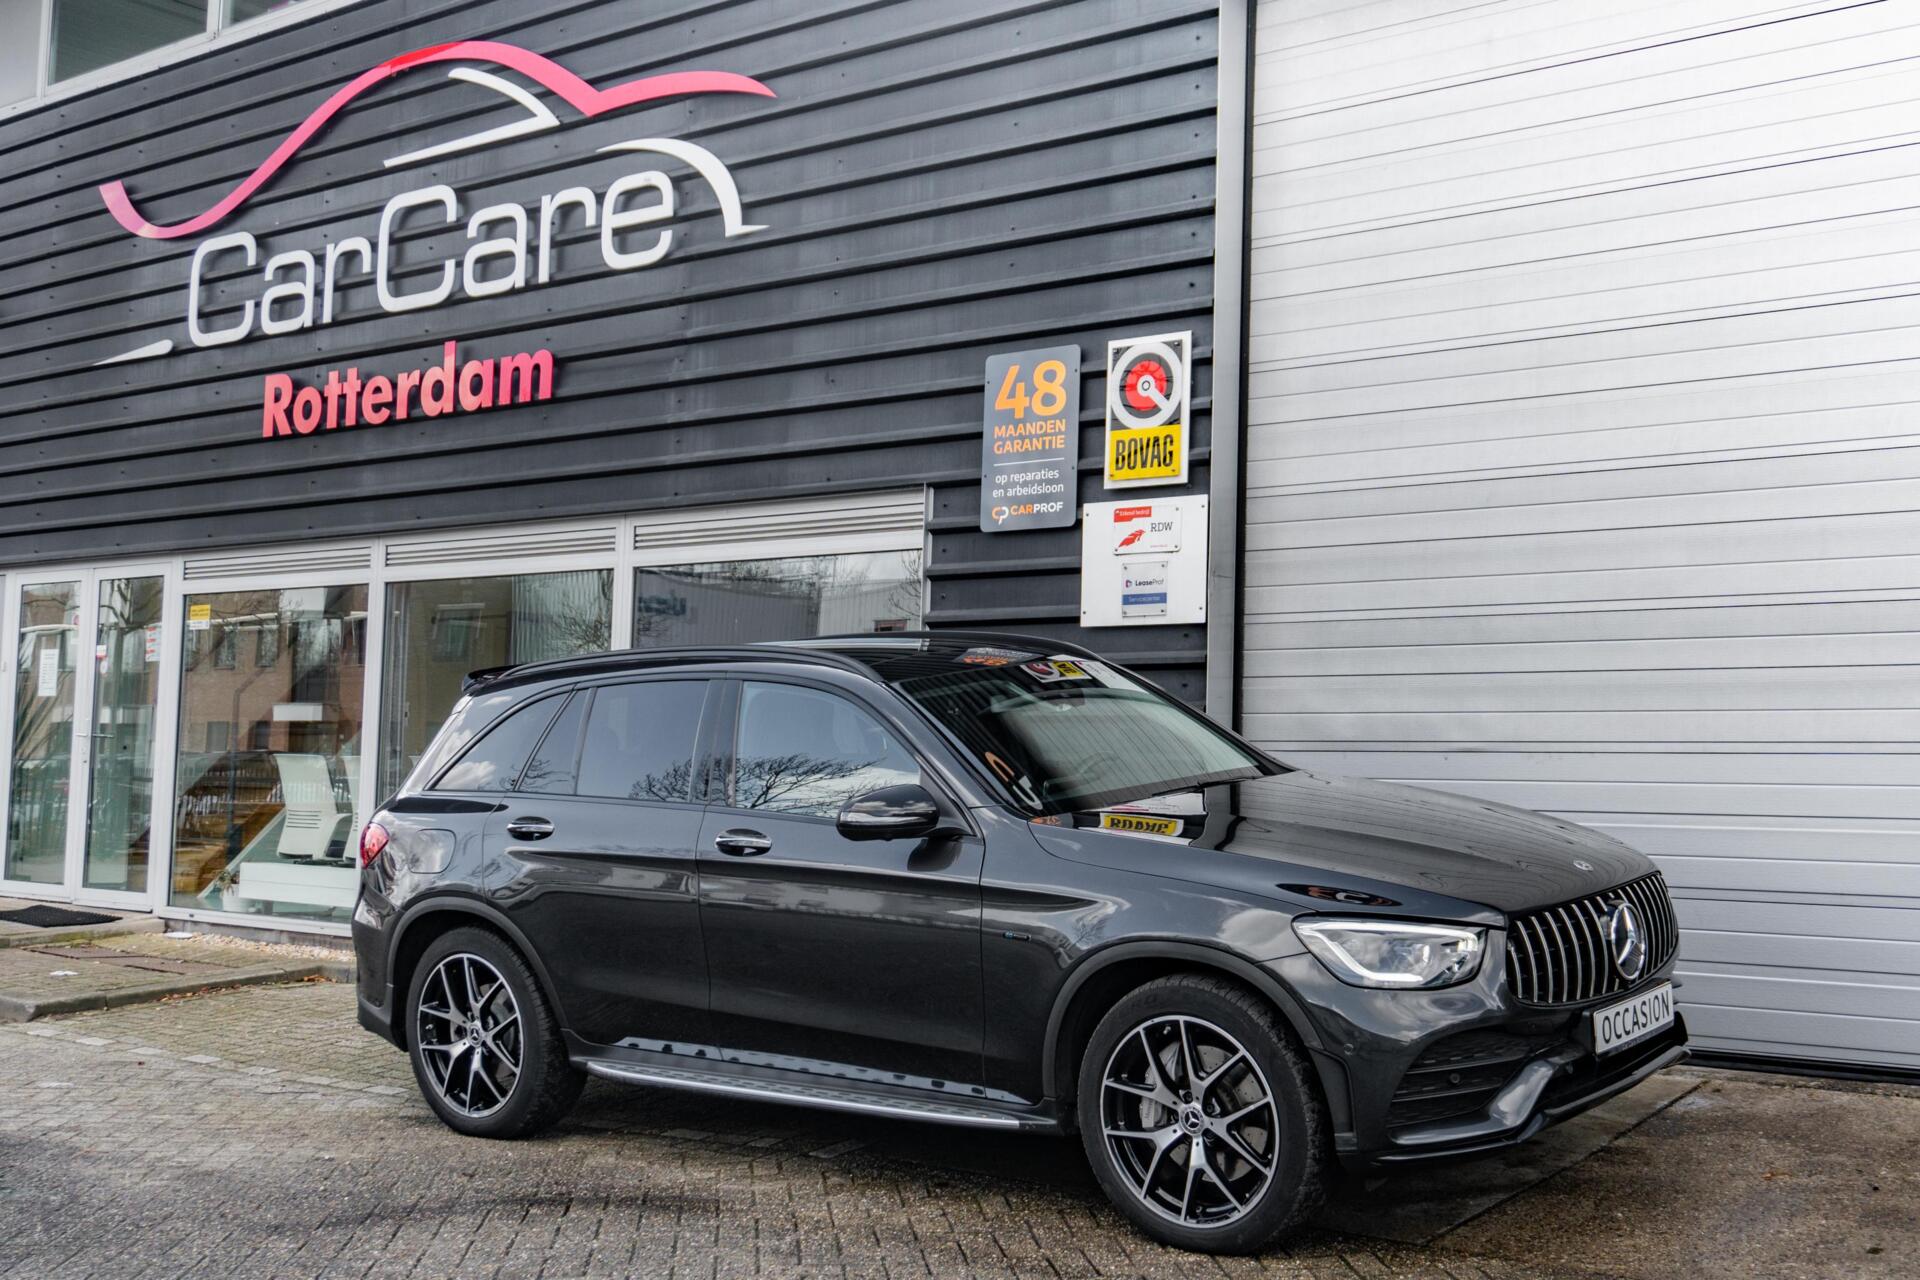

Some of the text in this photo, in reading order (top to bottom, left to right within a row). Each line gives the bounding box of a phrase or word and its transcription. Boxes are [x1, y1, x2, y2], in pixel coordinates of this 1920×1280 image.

[188, 170, 674, 347] CarCare
[262, 340, 553, 437] Rotterdam
[995, 360, 1066, 419] 48
[993, 419, 1066, 439] MAANDEN
[993, 435, 1065, 455] GARANTIE
[1115, 434, 1174, 471] BOVAG
[995, 468, 1060, 486] op reparaties
[992, 483, 1064, 498] en arbeidsloon
[1010, 502, 1064, 515] CARPROF
[1150, 521, 1173, 532] RDW
[1602, 990, 1670, 1044] OCCASION
